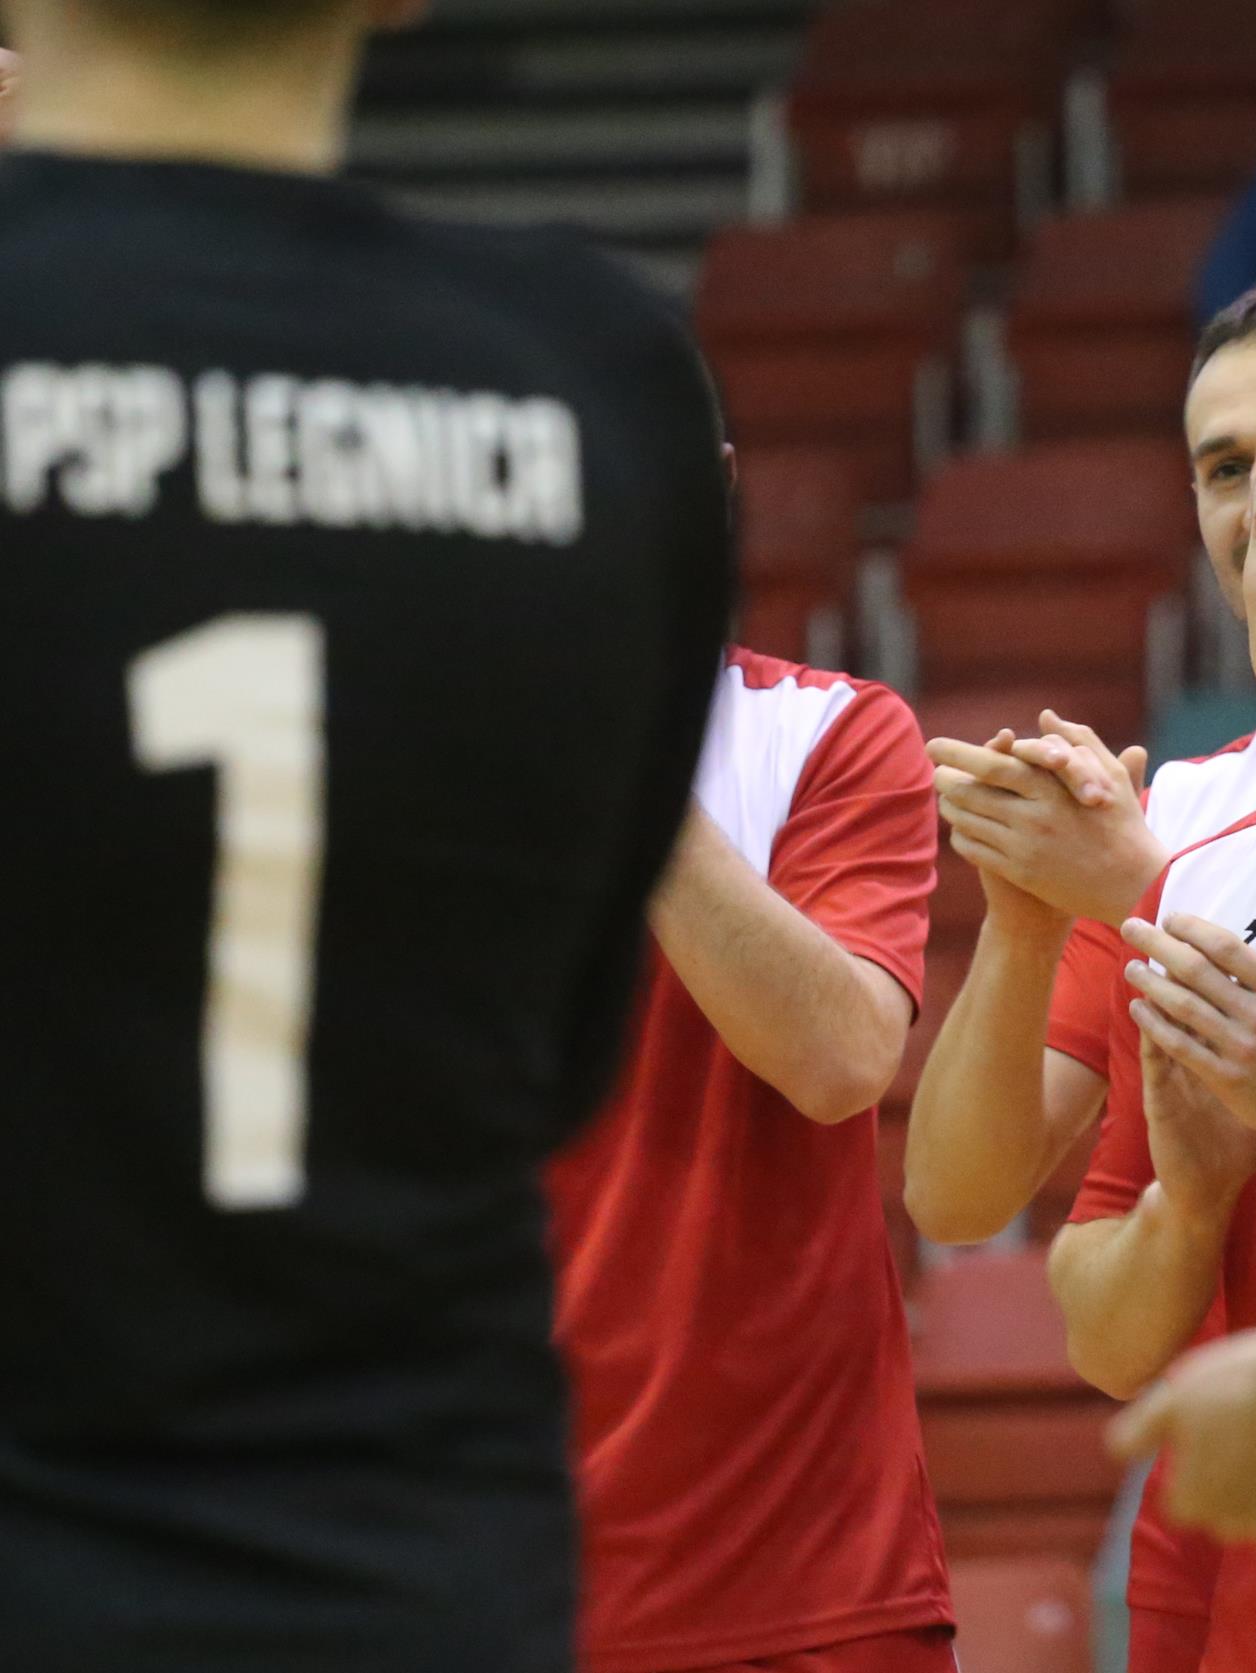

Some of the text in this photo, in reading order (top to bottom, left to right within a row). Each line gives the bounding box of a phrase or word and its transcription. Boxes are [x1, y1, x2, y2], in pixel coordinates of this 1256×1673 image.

[2, 363, 583, 543] PSP LEGNICA
[128, 614, 325, 1208] 1
